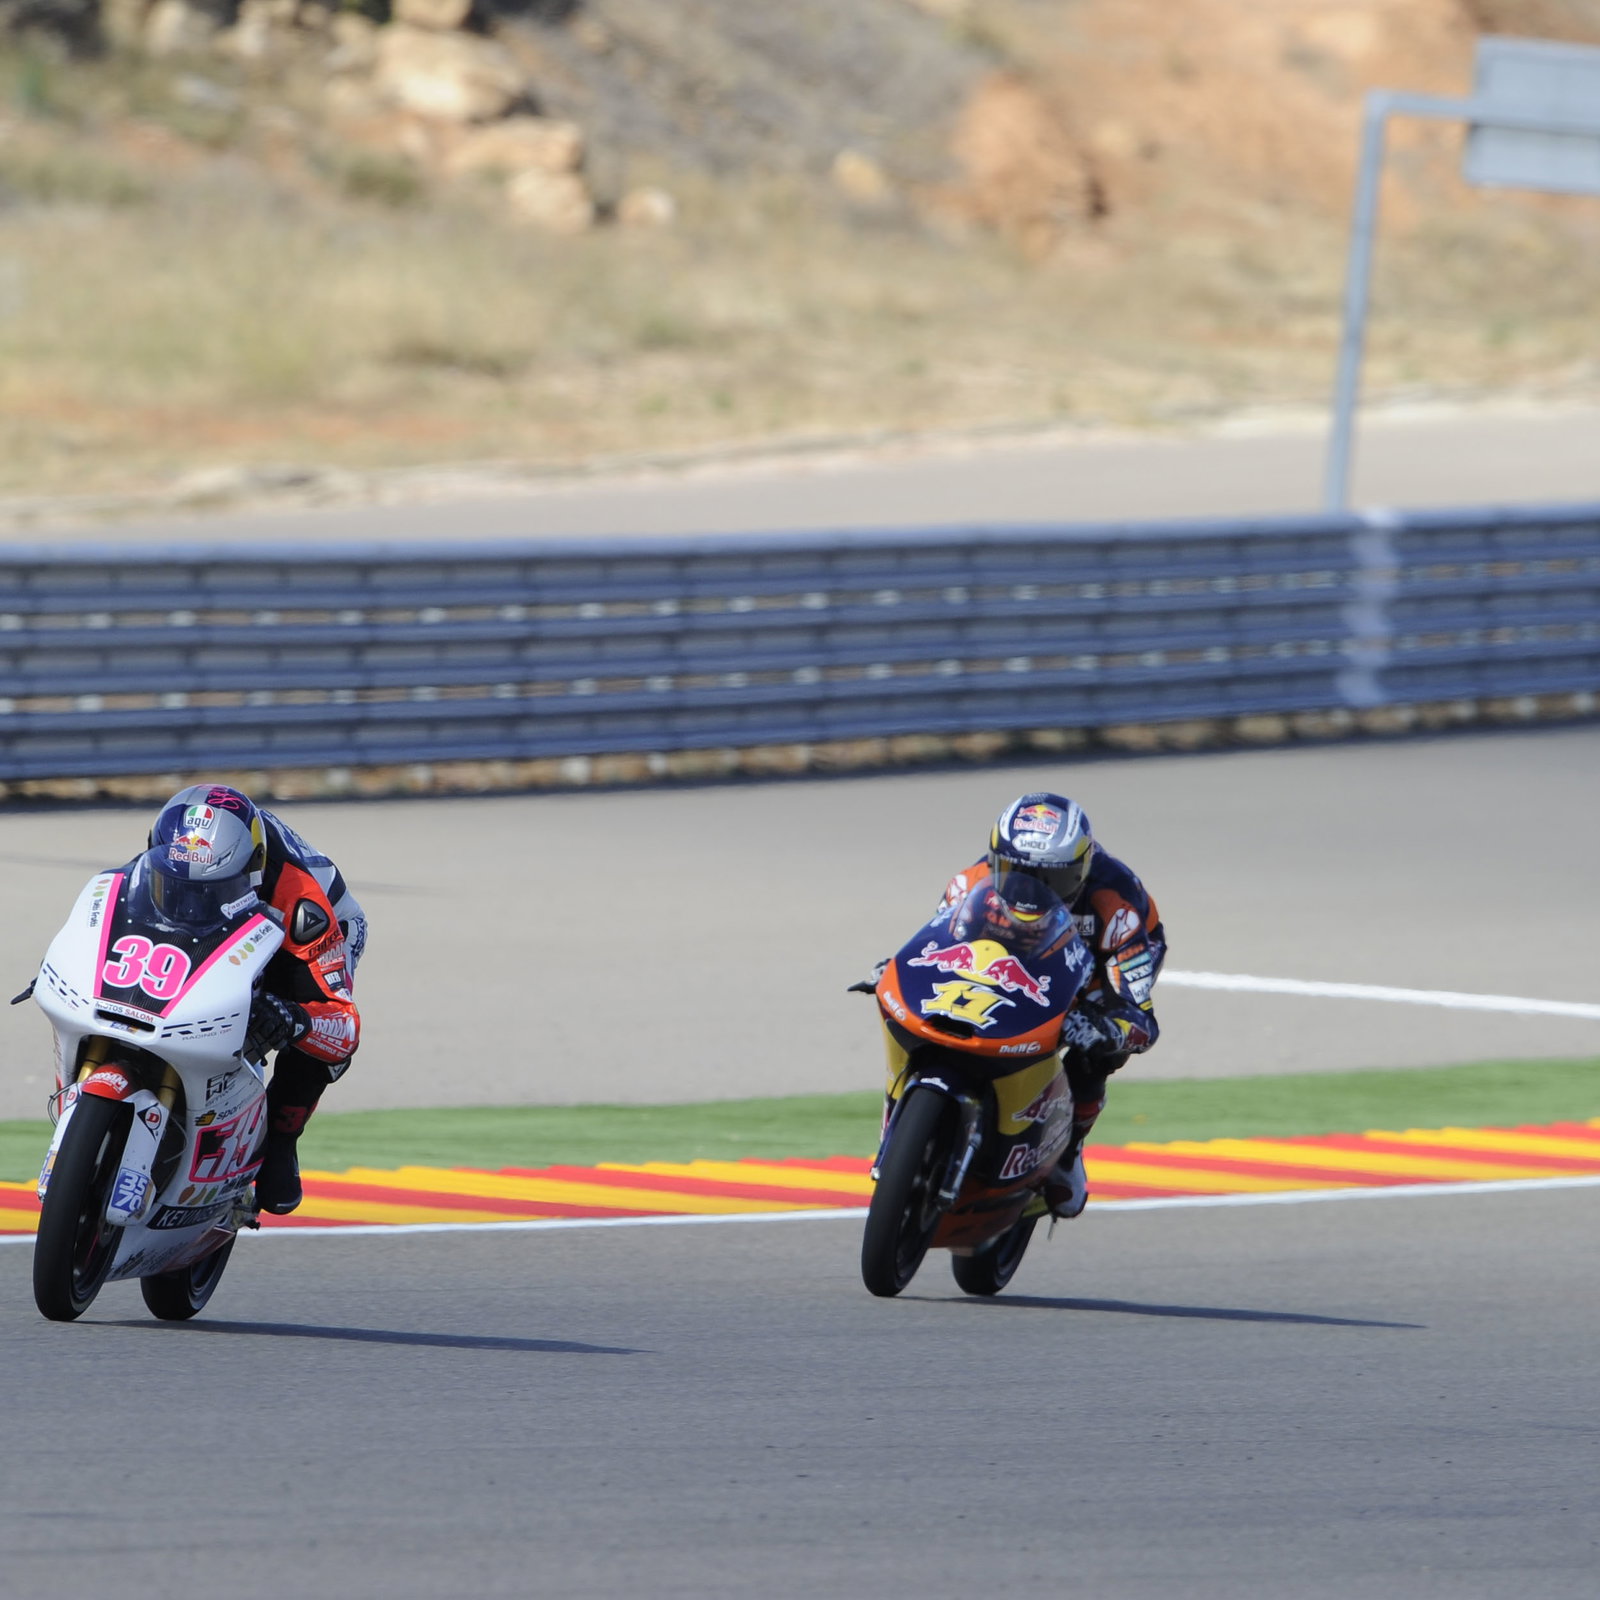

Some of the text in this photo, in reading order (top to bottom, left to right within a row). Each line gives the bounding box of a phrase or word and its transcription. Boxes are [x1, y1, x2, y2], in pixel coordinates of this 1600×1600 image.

[169, 848, 213, 865] Red Bull
[102, 935, 192, 1000] 39
[124, 1008, 154, 1023] SALOM
